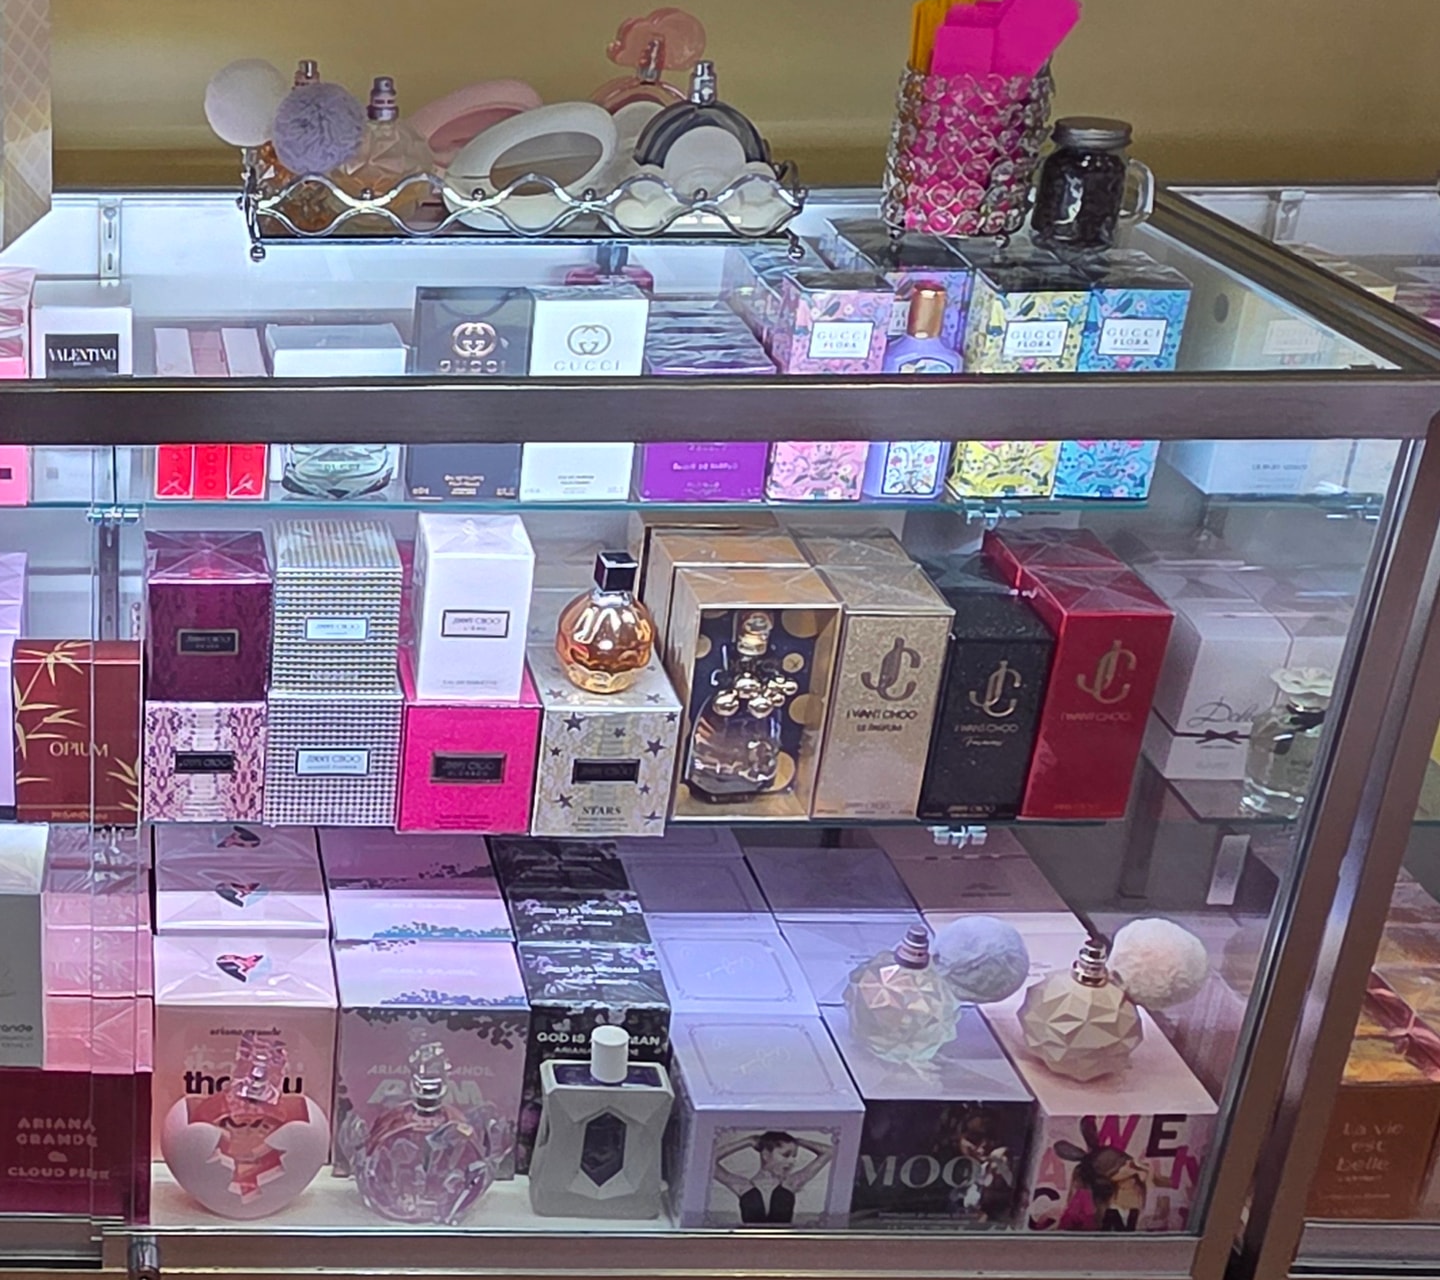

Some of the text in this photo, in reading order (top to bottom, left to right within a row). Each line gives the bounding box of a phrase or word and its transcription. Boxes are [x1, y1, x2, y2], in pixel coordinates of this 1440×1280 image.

[816, 330, 867, 340] GUCCI
[1011, 329, 1063, 339] GUCCI
[1106, 327, 1161, 338] GUCCI
[823, 341, 857, 349] FLORA
[1017, 340, 1051, 348] FLORA
[1113, 338, 1149, 346] FLORA
[48, 347, 117, 362] VALENTINO
[439, 360, 507, 373] GUCCI
[553, 360, 621, 372] GUCCI
[852, 709, 880, 719] WANT
[882, 710, 919, 720] CHOO
[49, 741, 109, 758] OPIUM
[582, 805, 622, 815] STARS
[536, 1032, 569, 1043] GOD
[572, 1033, 586, 1043] IS
[17, 1117, 96, 1132] ARIANA
[1343, 1121, 1404, 1135] La vie
[16, 1133, 98, 1147] GRANDE
[1351, 1140, 1384, 1153] est
[1336, 1156, 1390, 1172] belle
[7, 1166, 66, 1178] CLOUD
